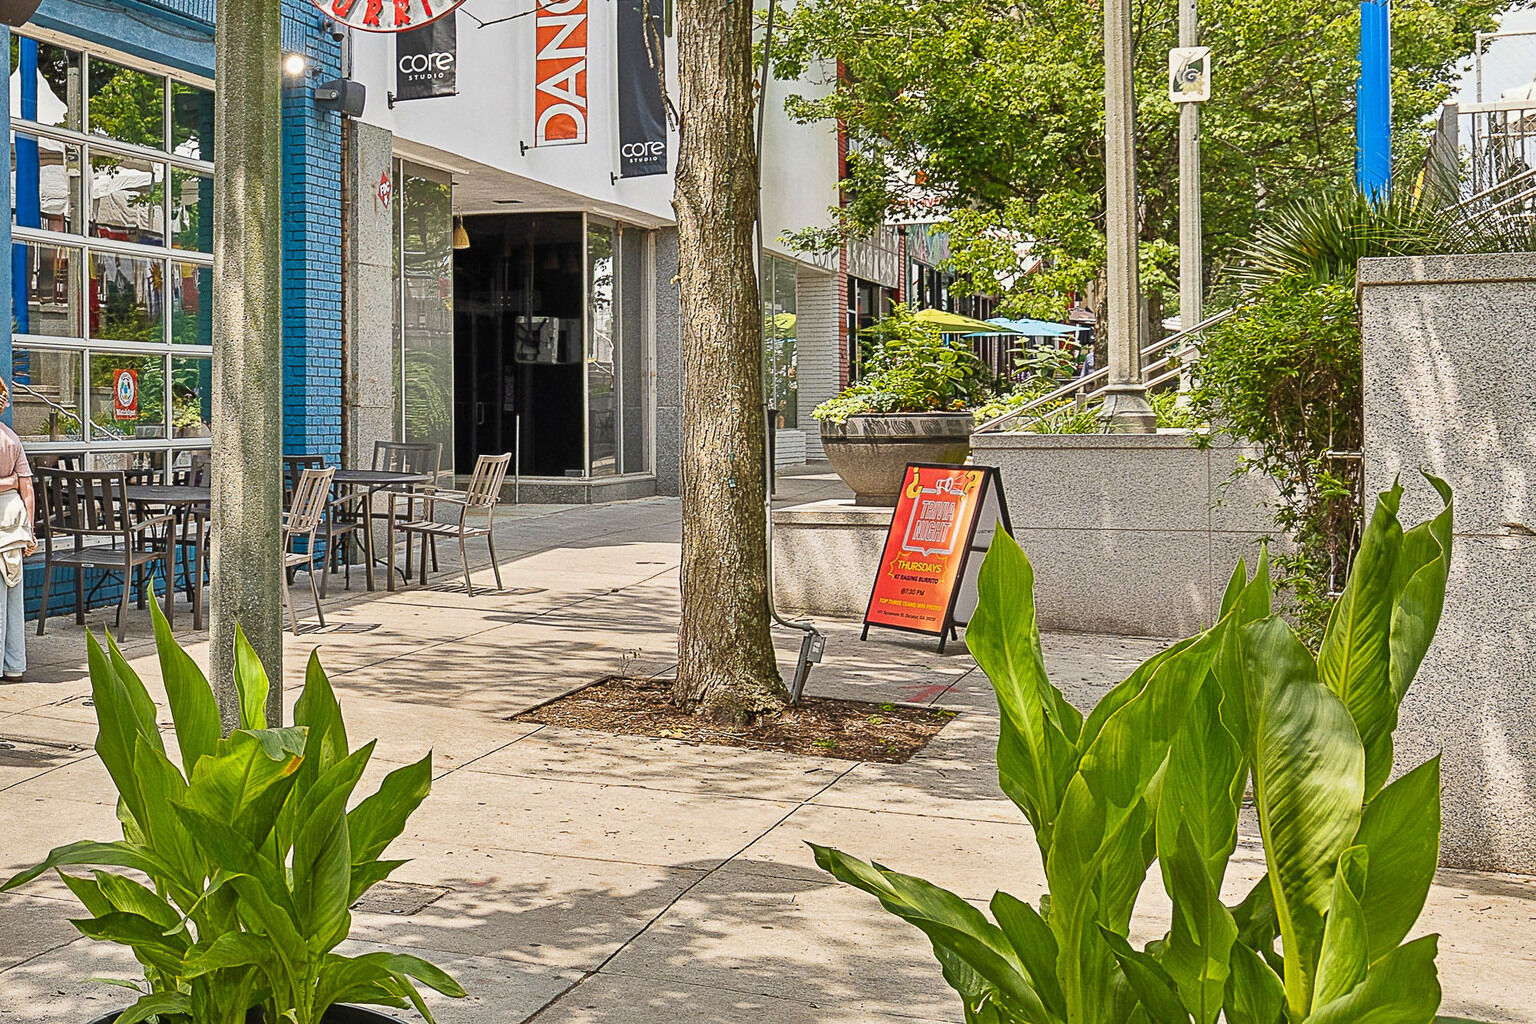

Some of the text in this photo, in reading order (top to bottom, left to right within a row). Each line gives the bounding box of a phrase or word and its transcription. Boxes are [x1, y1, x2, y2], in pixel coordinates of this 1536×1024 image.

[399, 52, 455, 74] core
[408, 72, 444, 81] STUDIO
[621, 141, 665, 158] core
[629, 156, 658, 164] STUDIO
[920, 500, 955, 521] TRIVIA
[912, 520, 952, 543] NIGHT
[897, 559, 943, 574] THURSDAYS
[901, 574, 918, 582] RAGING
[918, 576, 939, 585] BURRITO
